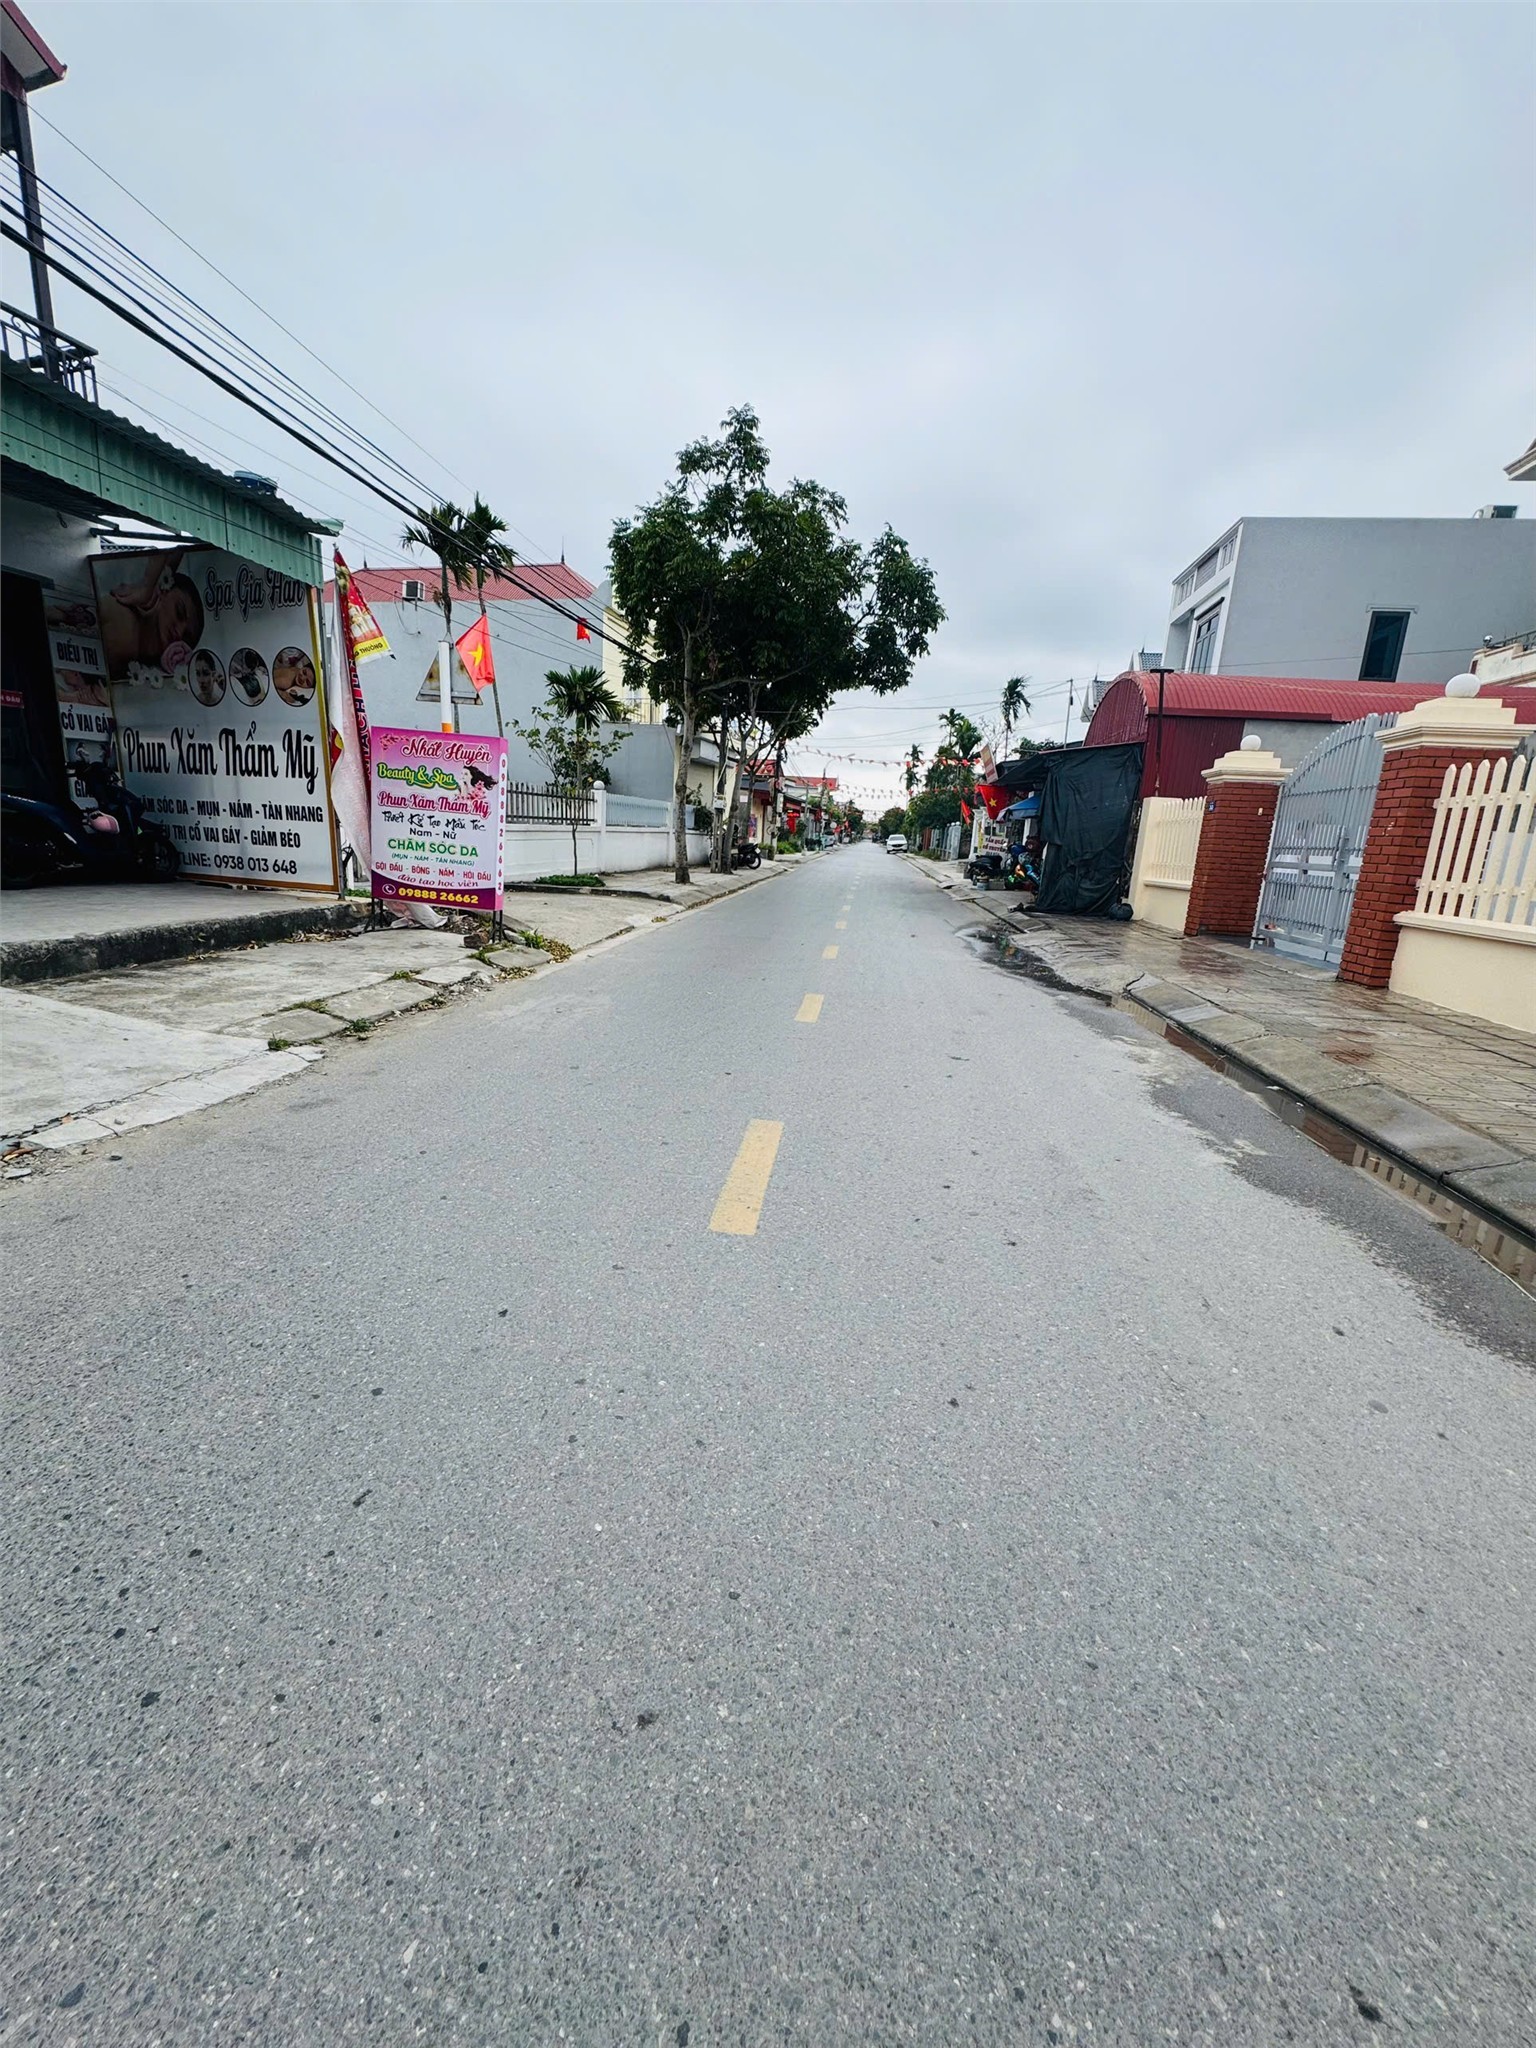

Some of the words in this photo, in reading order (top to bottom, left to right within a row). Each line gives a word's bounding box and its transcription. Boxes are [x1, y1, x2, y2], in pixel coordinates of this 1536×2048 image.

[204, 567, 235, 620] Spa
[238, 564, 266, 622] Gia
[76, 713, 94, 732] VAI
[123, 727, 170, 774] Phun
[171, 727, 218, 776] Xăm
[218, 720, 279, 778] Thẩm
[283, 729, 318, 795] Mỹ
[402, 737, 443, 758] Nhất
[446, 744, 491, 766] Huyền
[378, 763, 418, 786] Beauty
[418, 766, 429, 781] &
[432, 766, 457, 788] Spa
[157, 796, 174, 814] SÓC
[175, 799, 188, 815] DA
[197, 800, 220, 819] MỤN
[229, 799, 253, 819] NÁM
[261, 801, 281, 820] TÀN
[285, 805, 323, 823] NHANG
[378, 791, 408, 807] Phun
[410, 794, 436, 810] Xăm
[189, 820, 201, 842] CỔ
[203, 827, 220, 842] VAI
[222, 825, 241, 844] GÁY
[251, 825, 278, 847] GIẢM
[280, 828, 301, 849] BÉO
[410, 828, 432, 837] Nam
[388, 838, 425, 852] CHĂM
[460, 846, 478, 857] DA
[214, 854, 244, 871] 0938
[247, 857, 269, 872] 013
[272, 860, 297, 874] 648
[398, 887, 437, 899] 09888
[439, 892, 479, 904] 26662
